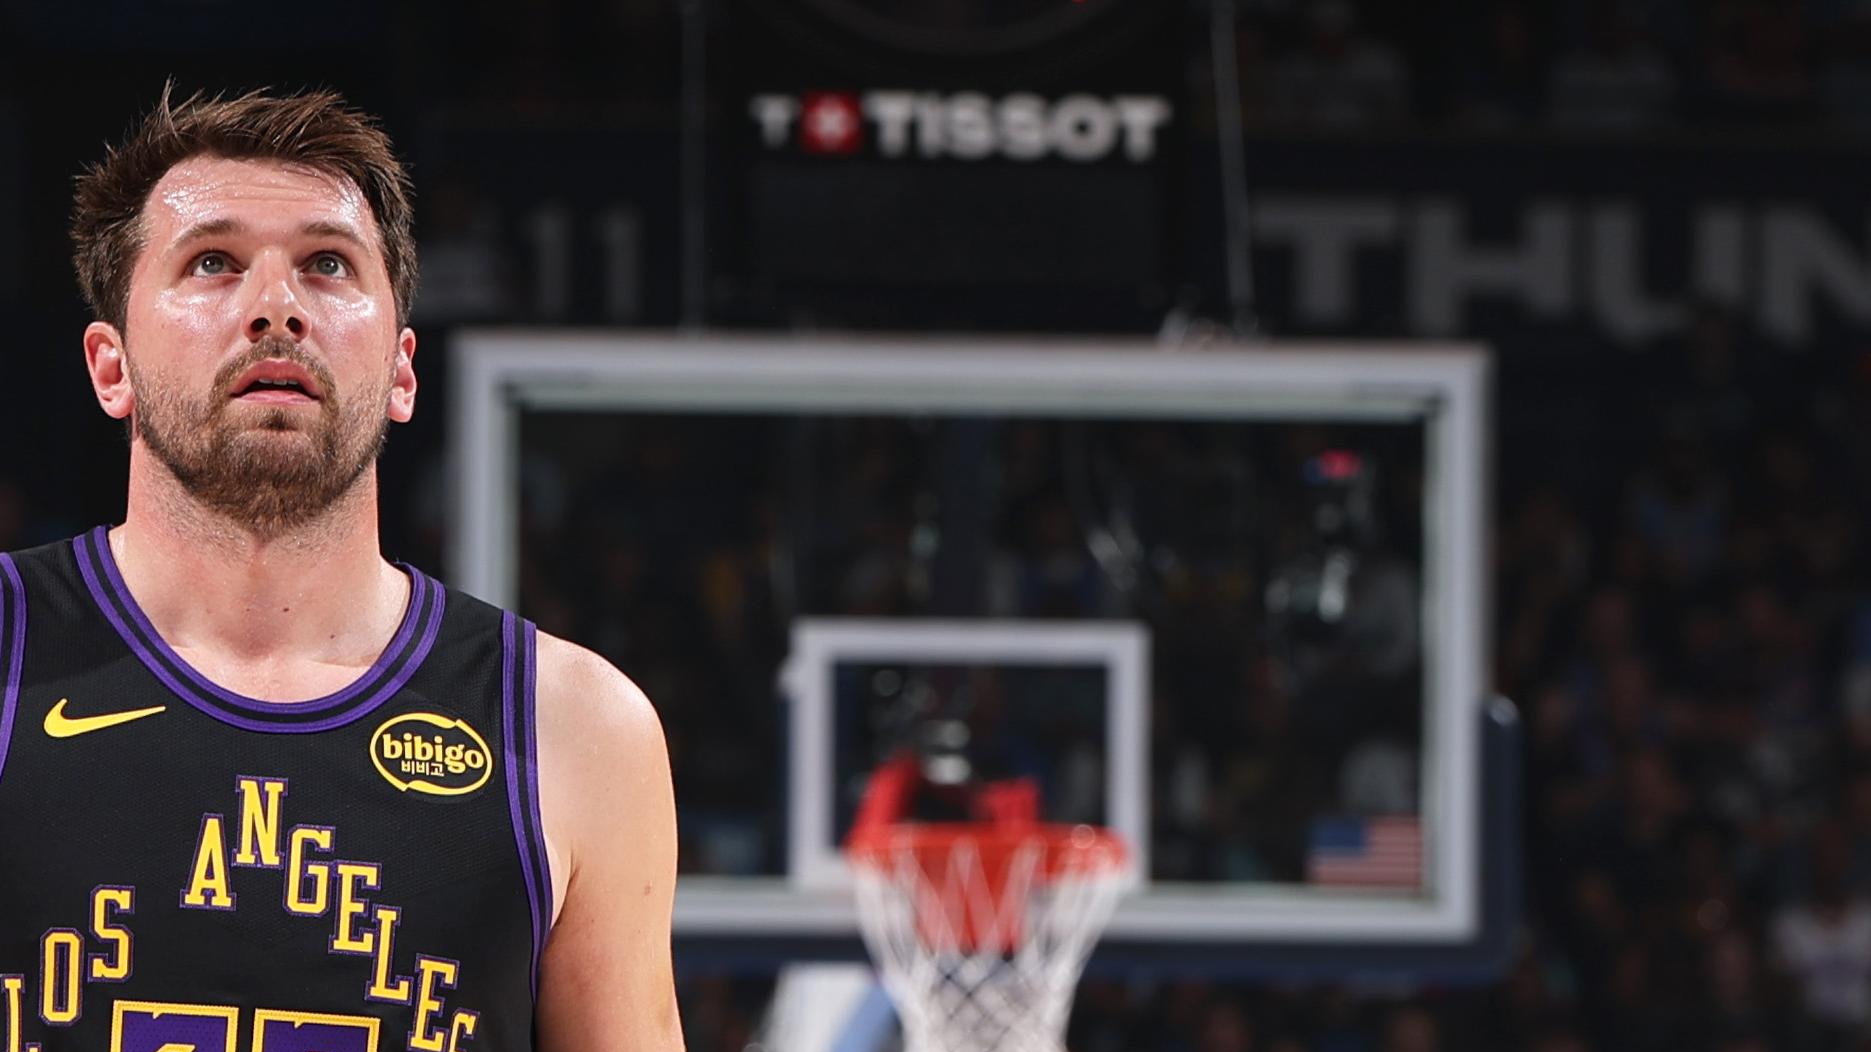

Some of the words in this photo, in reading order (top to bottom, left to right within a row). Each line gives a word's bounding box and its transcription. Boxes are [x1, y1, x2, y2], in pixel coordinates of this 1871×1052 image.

[863, 89, 1174, 162] TISSOT
[382, 732, 485, 774] bibigo
[401, 760, 445, 777] 비비고
